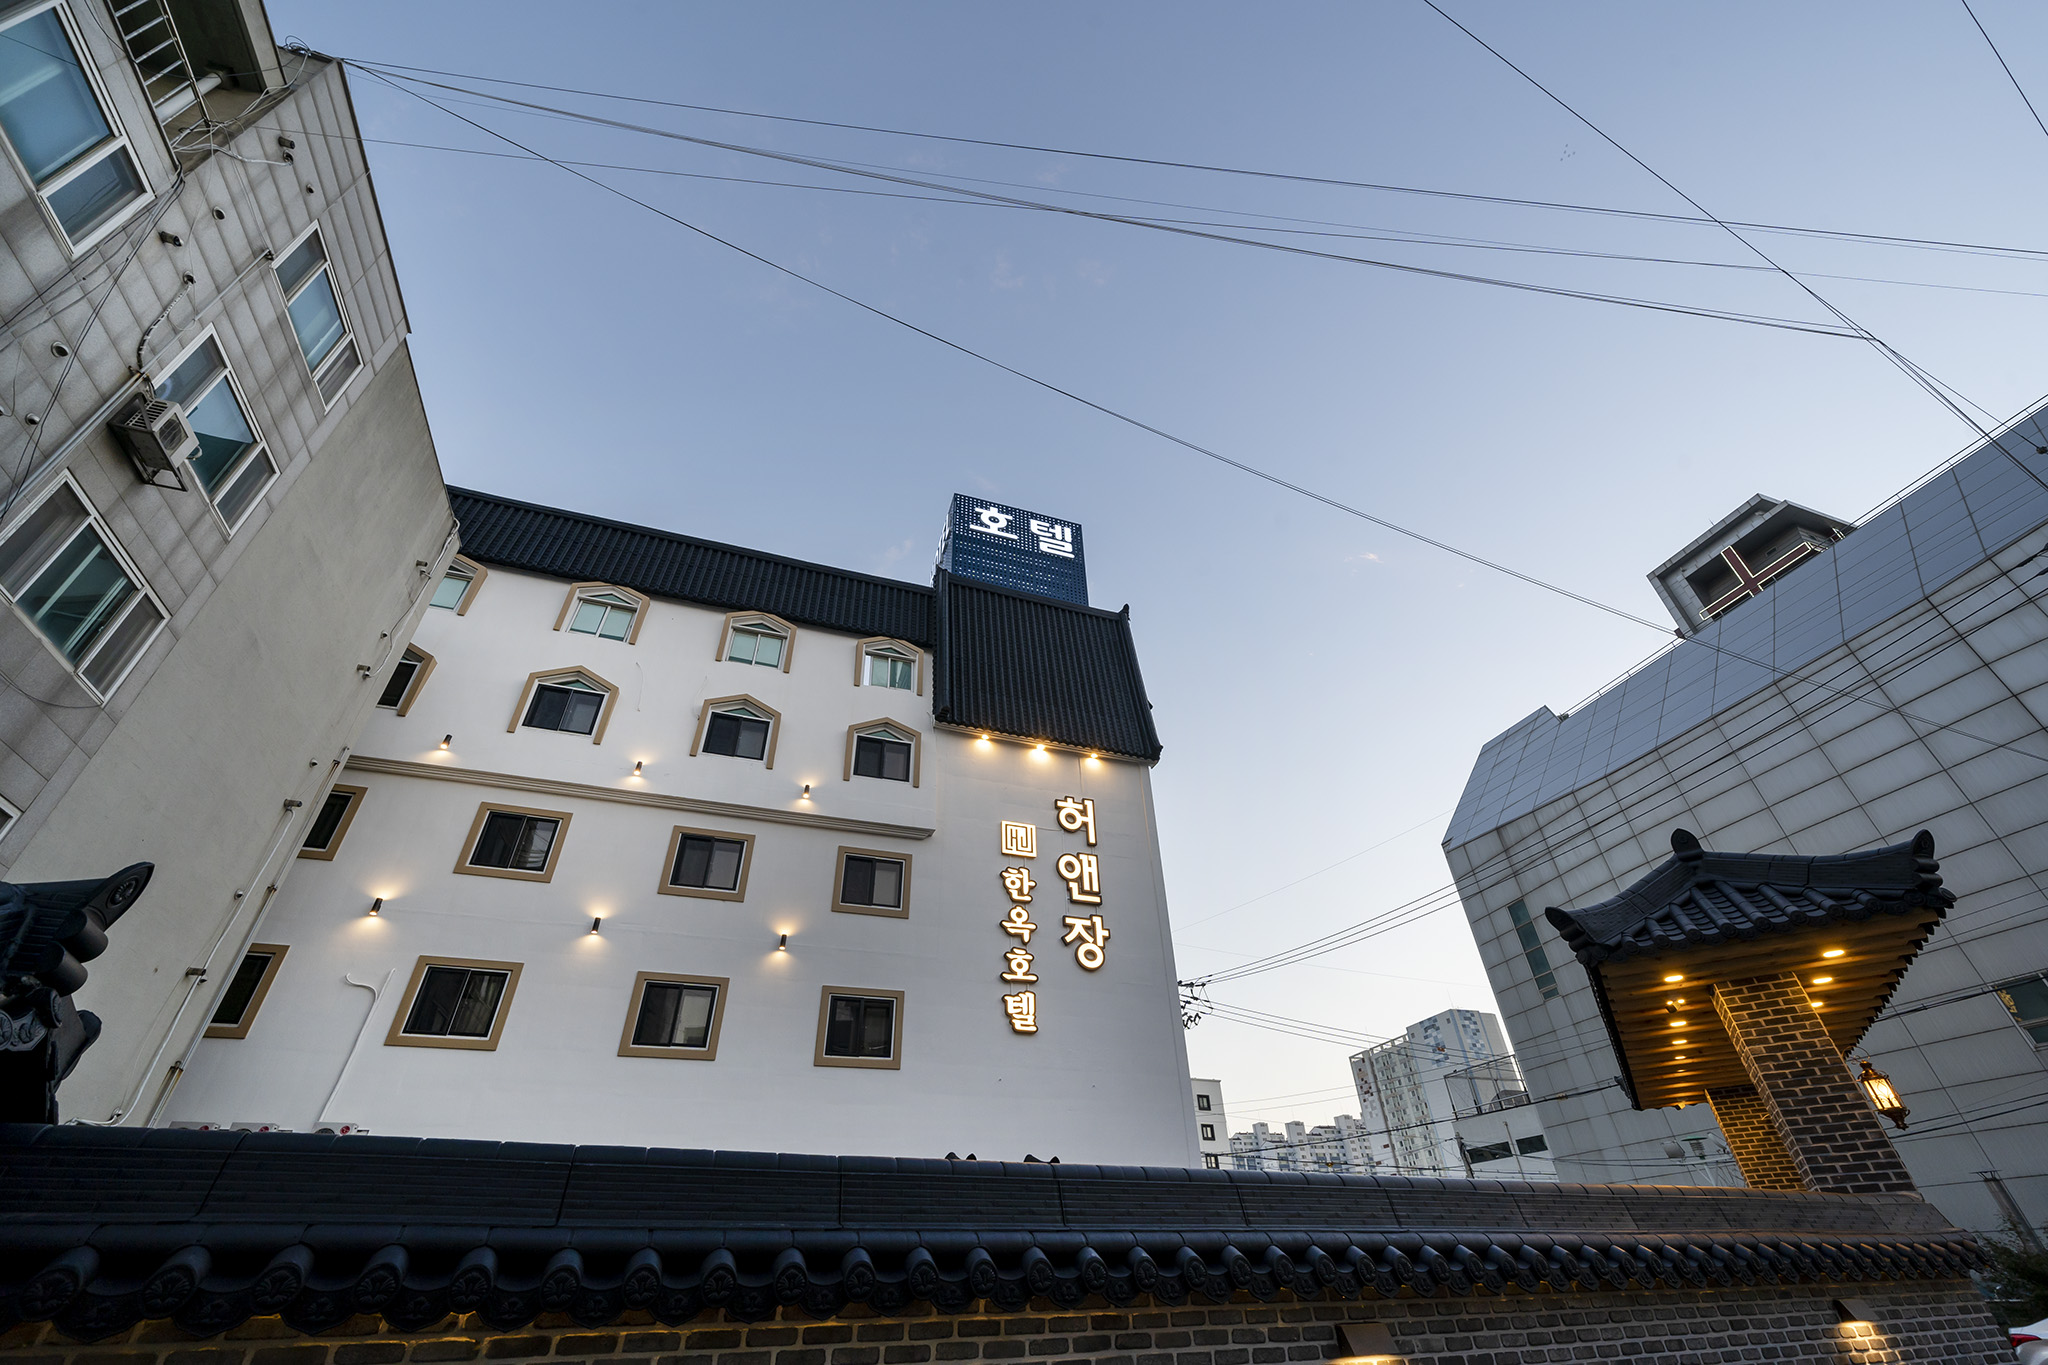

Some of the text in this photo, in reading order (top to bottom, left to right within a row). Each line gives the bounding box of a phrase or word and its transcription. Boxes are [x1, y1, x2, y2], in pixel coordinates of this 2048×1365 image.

[970, 507, 1075, 559] 호텔
[1000, 866, 1039, 1034] 한옥호텔
[1055, 796, 1110, 971] 허앤장
